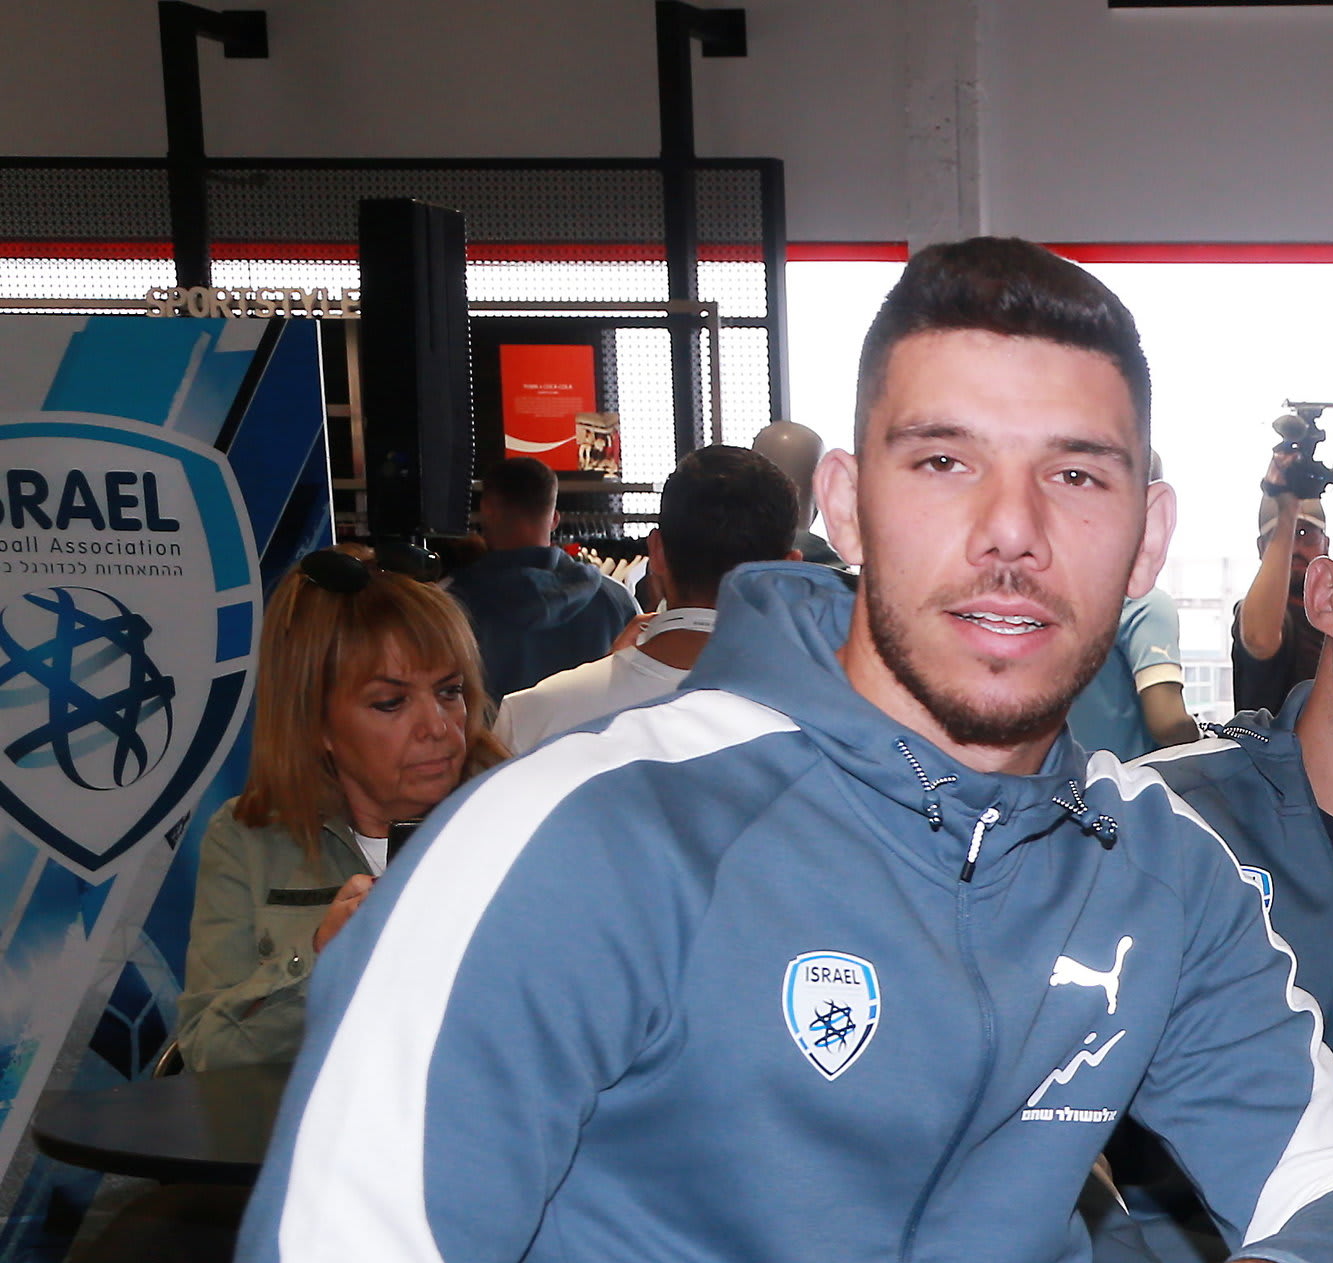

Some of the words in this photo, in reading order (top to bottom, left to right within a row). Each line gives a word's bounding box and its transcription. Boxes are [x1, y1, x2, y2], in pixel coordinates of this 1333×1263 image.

[146, 286, 362, 319] SPORTSTYLE
[0, 469, 181, 532] RAEL
[50, 537, 181, 556] Association
[19, 561, 87, 575] לכדורגל
[95, 563, 183, 577] ההתאחדות
[805, 966, 861, 985] ISRAEL
[1021, 1109, 1054, 1121] שחם
